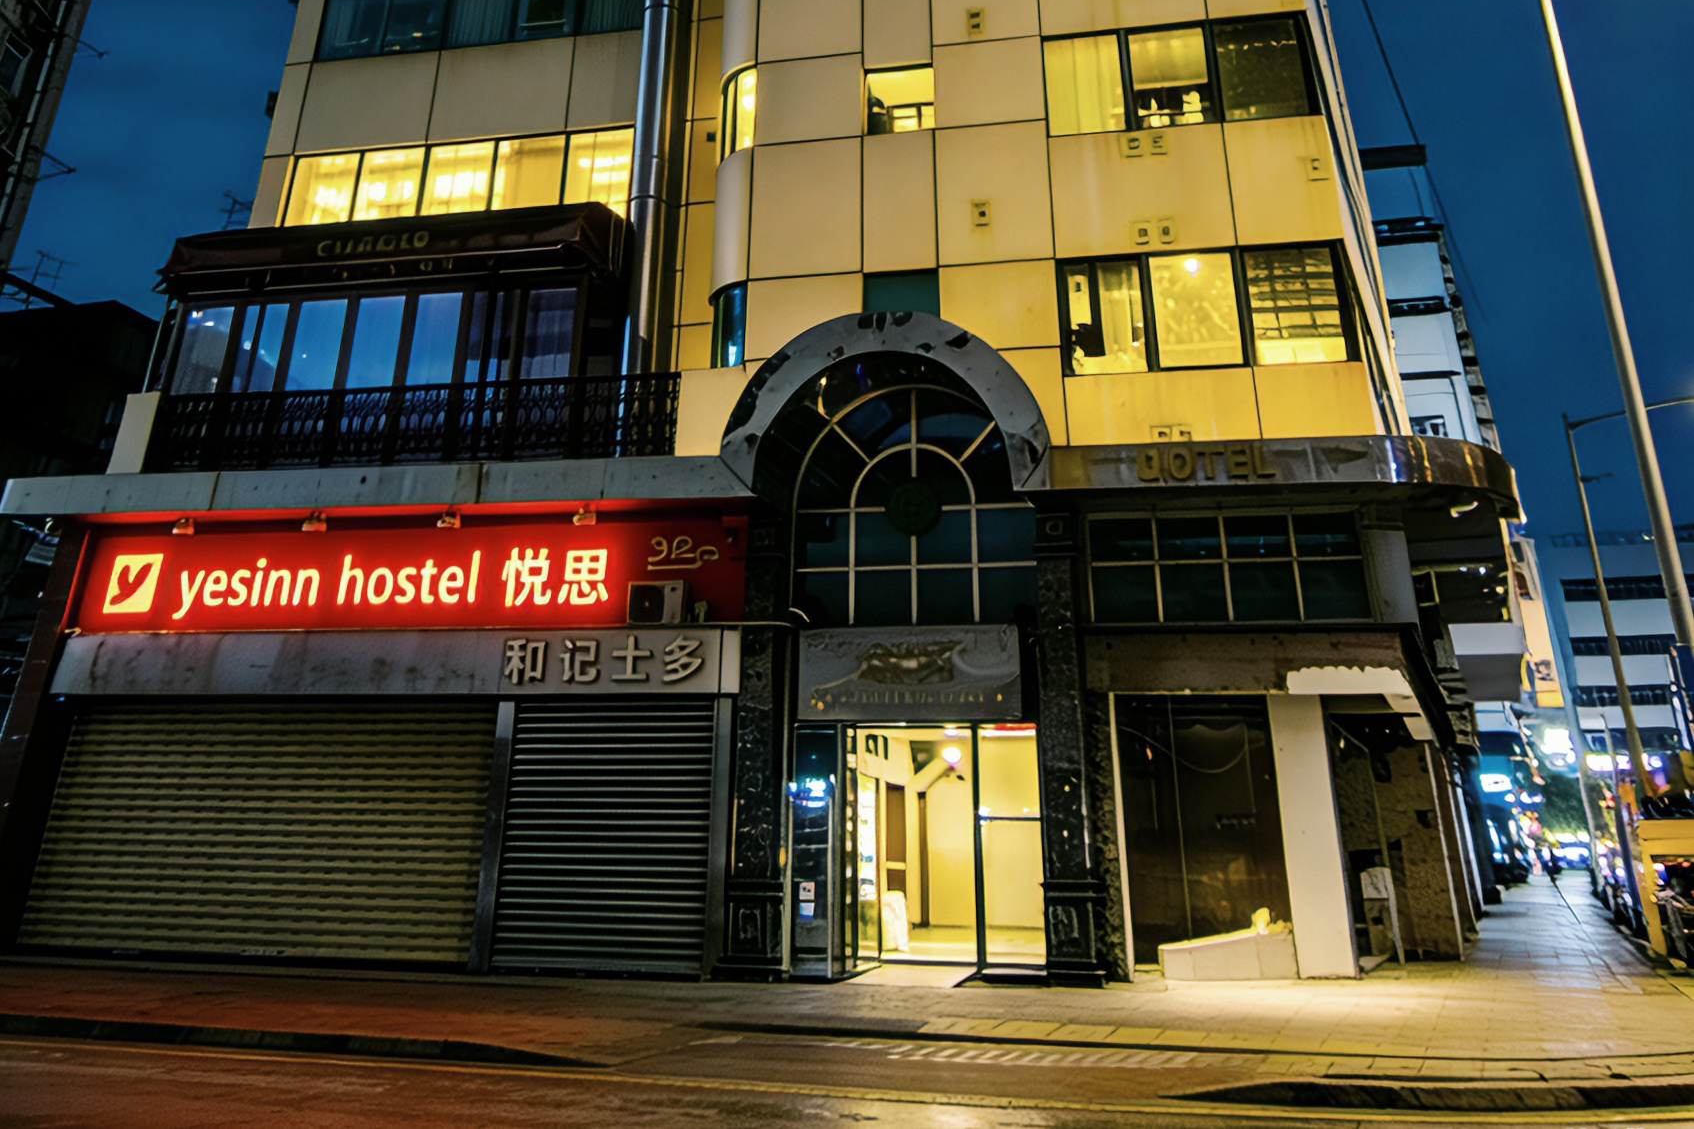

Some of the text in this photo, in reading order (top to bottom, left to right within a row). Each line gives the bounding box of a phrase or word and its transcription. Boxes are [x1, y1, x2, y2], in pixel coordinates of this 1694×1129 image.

[172, 550, 481, 620] yesinn hostel
[502, 547, 609, 607] 悦思
[504, 634, 703, 685] 和记士多
